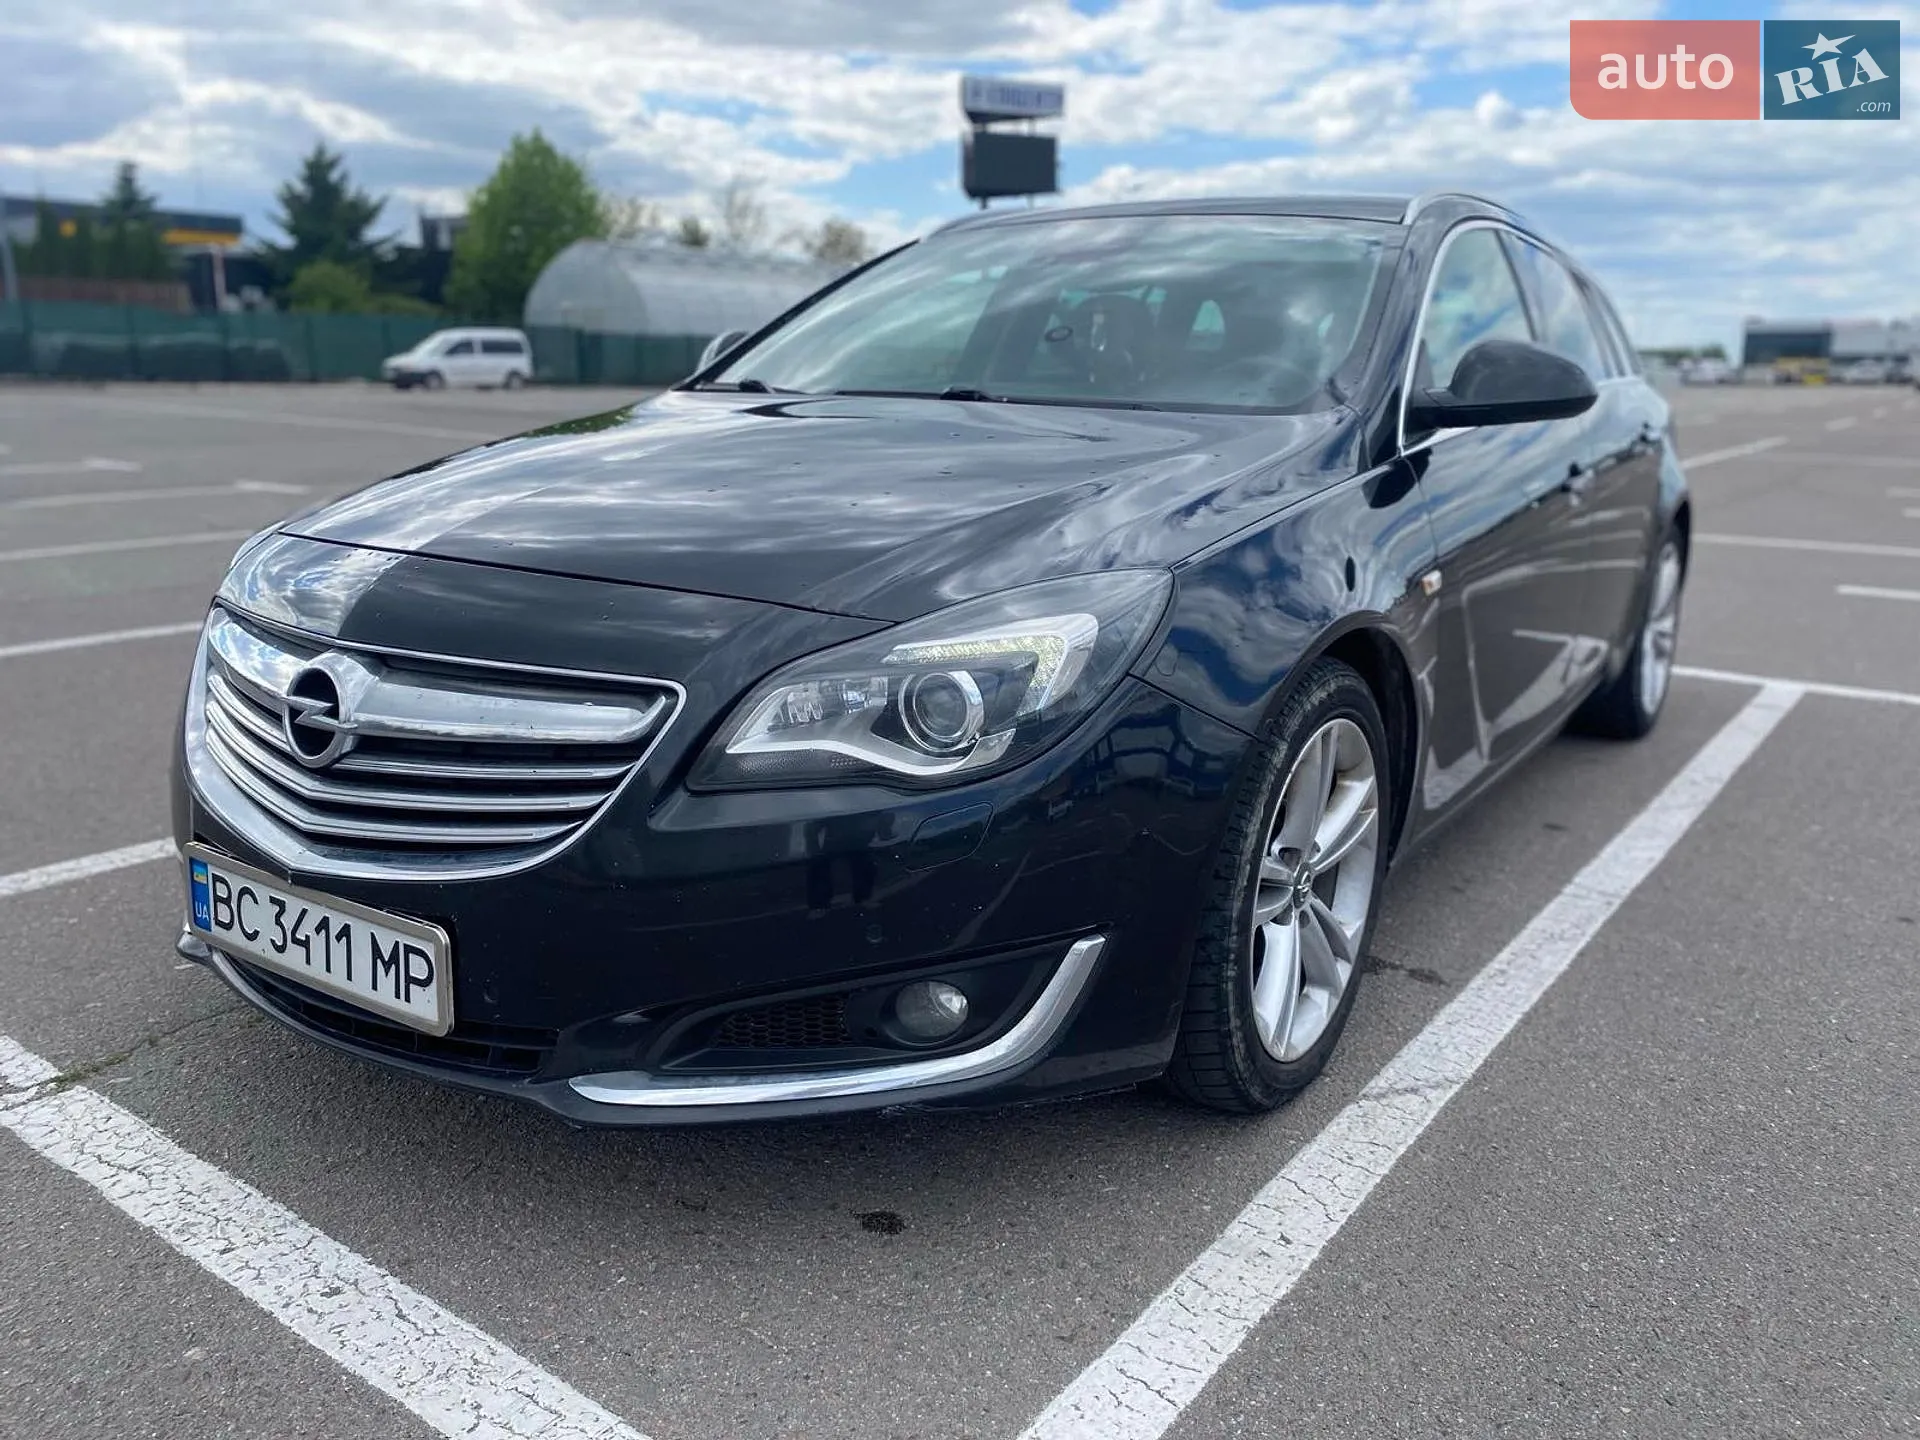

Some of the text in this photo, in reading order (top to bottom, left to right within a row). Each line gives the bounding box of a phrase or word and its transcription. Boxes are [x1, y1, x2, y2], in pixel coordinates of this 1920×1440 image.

[195, 901, 210, 922] UA
[211, 872, 435, 1004] BC 3411 MP
